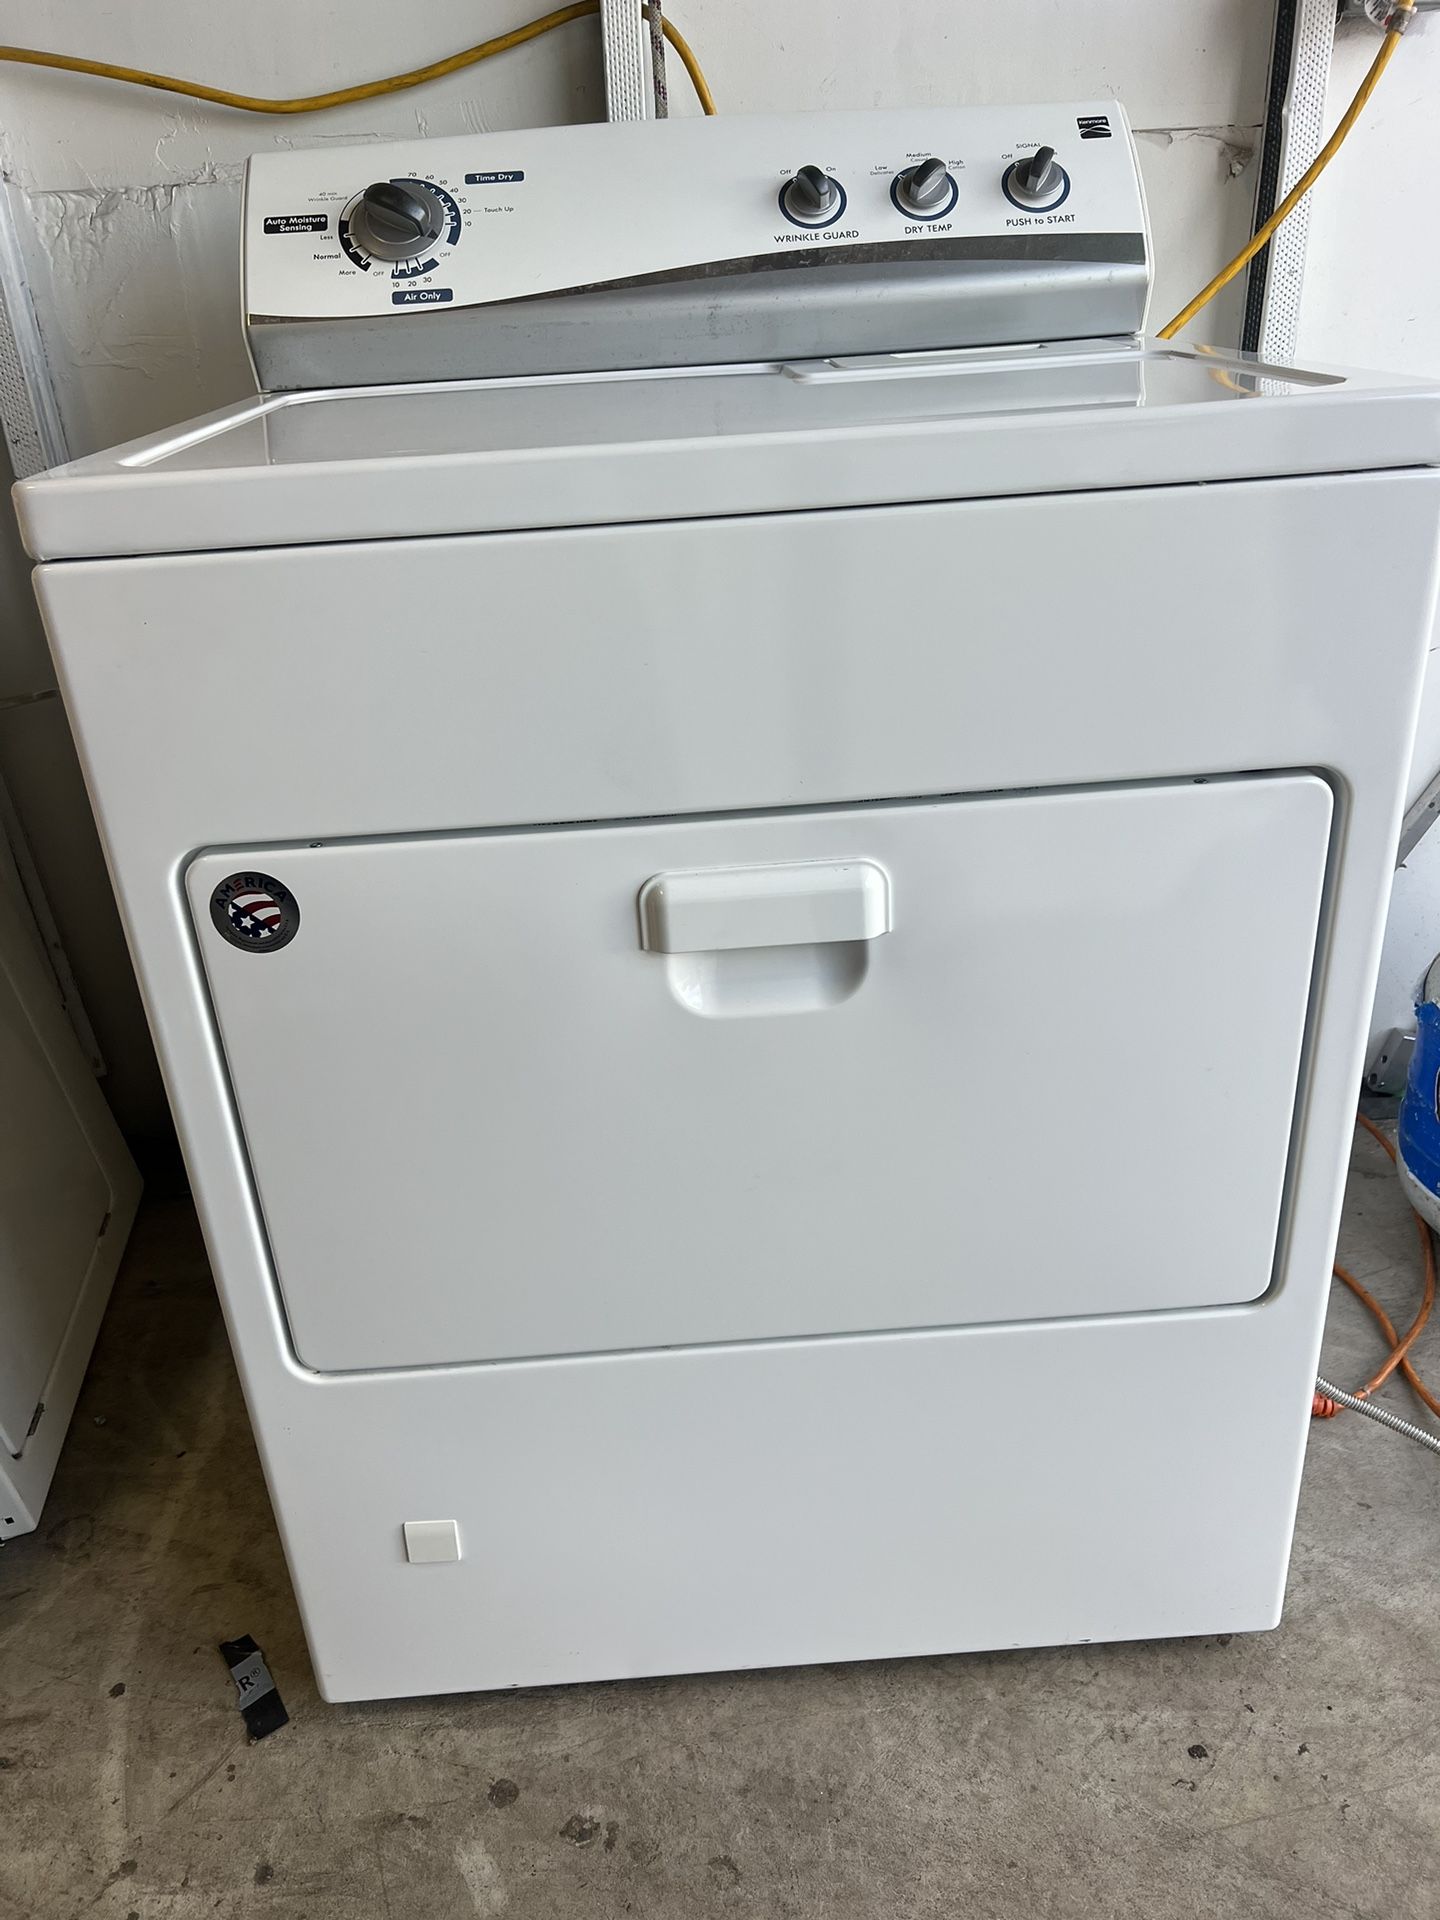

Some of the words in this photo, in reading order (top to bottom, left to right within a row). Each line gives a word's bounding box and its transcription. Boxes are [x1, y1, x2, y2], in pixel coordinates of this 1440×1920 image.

[475, 174, 496, 182] Time
[497, 172, 514, 183] Dry
[266, 217, 288, 225] Auto
[288, 216, 326, 225] Moisture
[1005, 217, 1032, 227] PUSH
[1034, 216, 1044, 225] to
[1047, 214, 1075, 224] START
[279, 223, 313, 232] Sensing
[905, 225, 924, 235] DRY
[927, 224, 953, 233] TEMP
[774, 232, 820, 243] WRINKLE
[823, 230, 859, 241] GUARD
[403, 292, 418, 301] Air
[419, 291, 441, 301] Only
[215, 876, 288, 910] AMERICA
